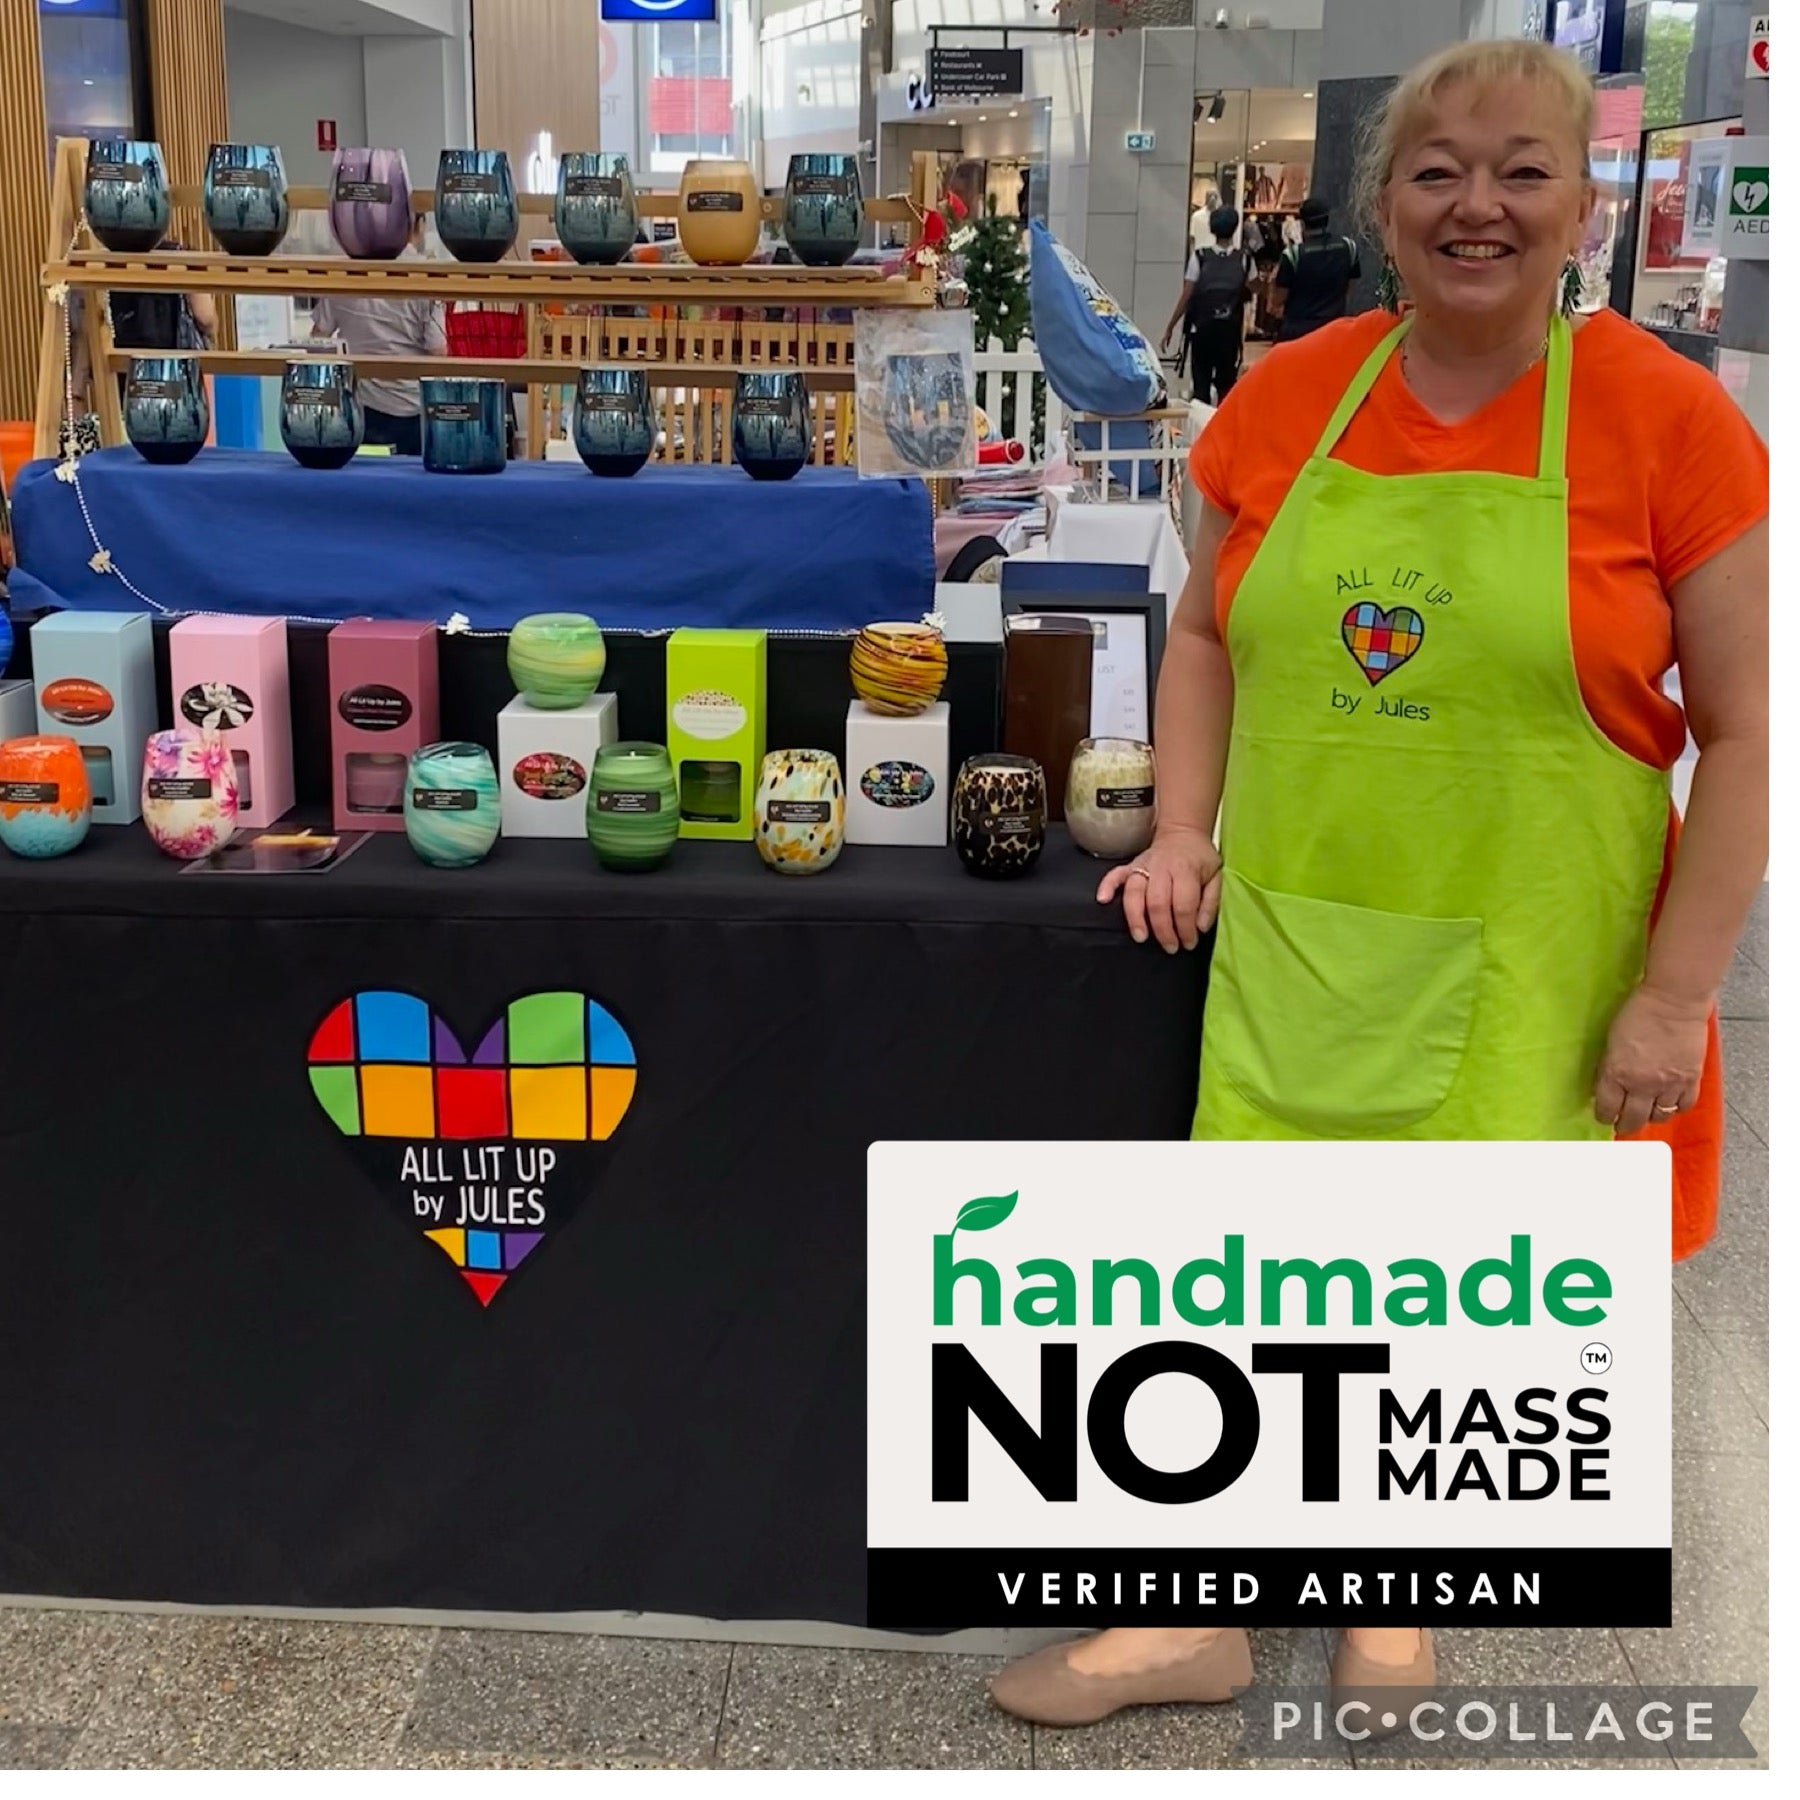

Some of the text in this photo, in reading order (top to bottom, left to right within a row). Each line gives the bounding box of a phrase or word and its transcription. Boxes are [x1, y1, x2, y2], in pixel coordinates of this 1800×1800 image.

[940, 61, 976, 69] Restaurants
[974, 73, 985, 81] Car
[986, 73, 1000, 81] Park
[1336, 566, 1453, 606] ALL LIT UP
[1331, 688, 1430, 721] by Jules
[400, 1146, 556, 1183] ALL LIT UP
[413, 1185, 546, 1225] by JULES
